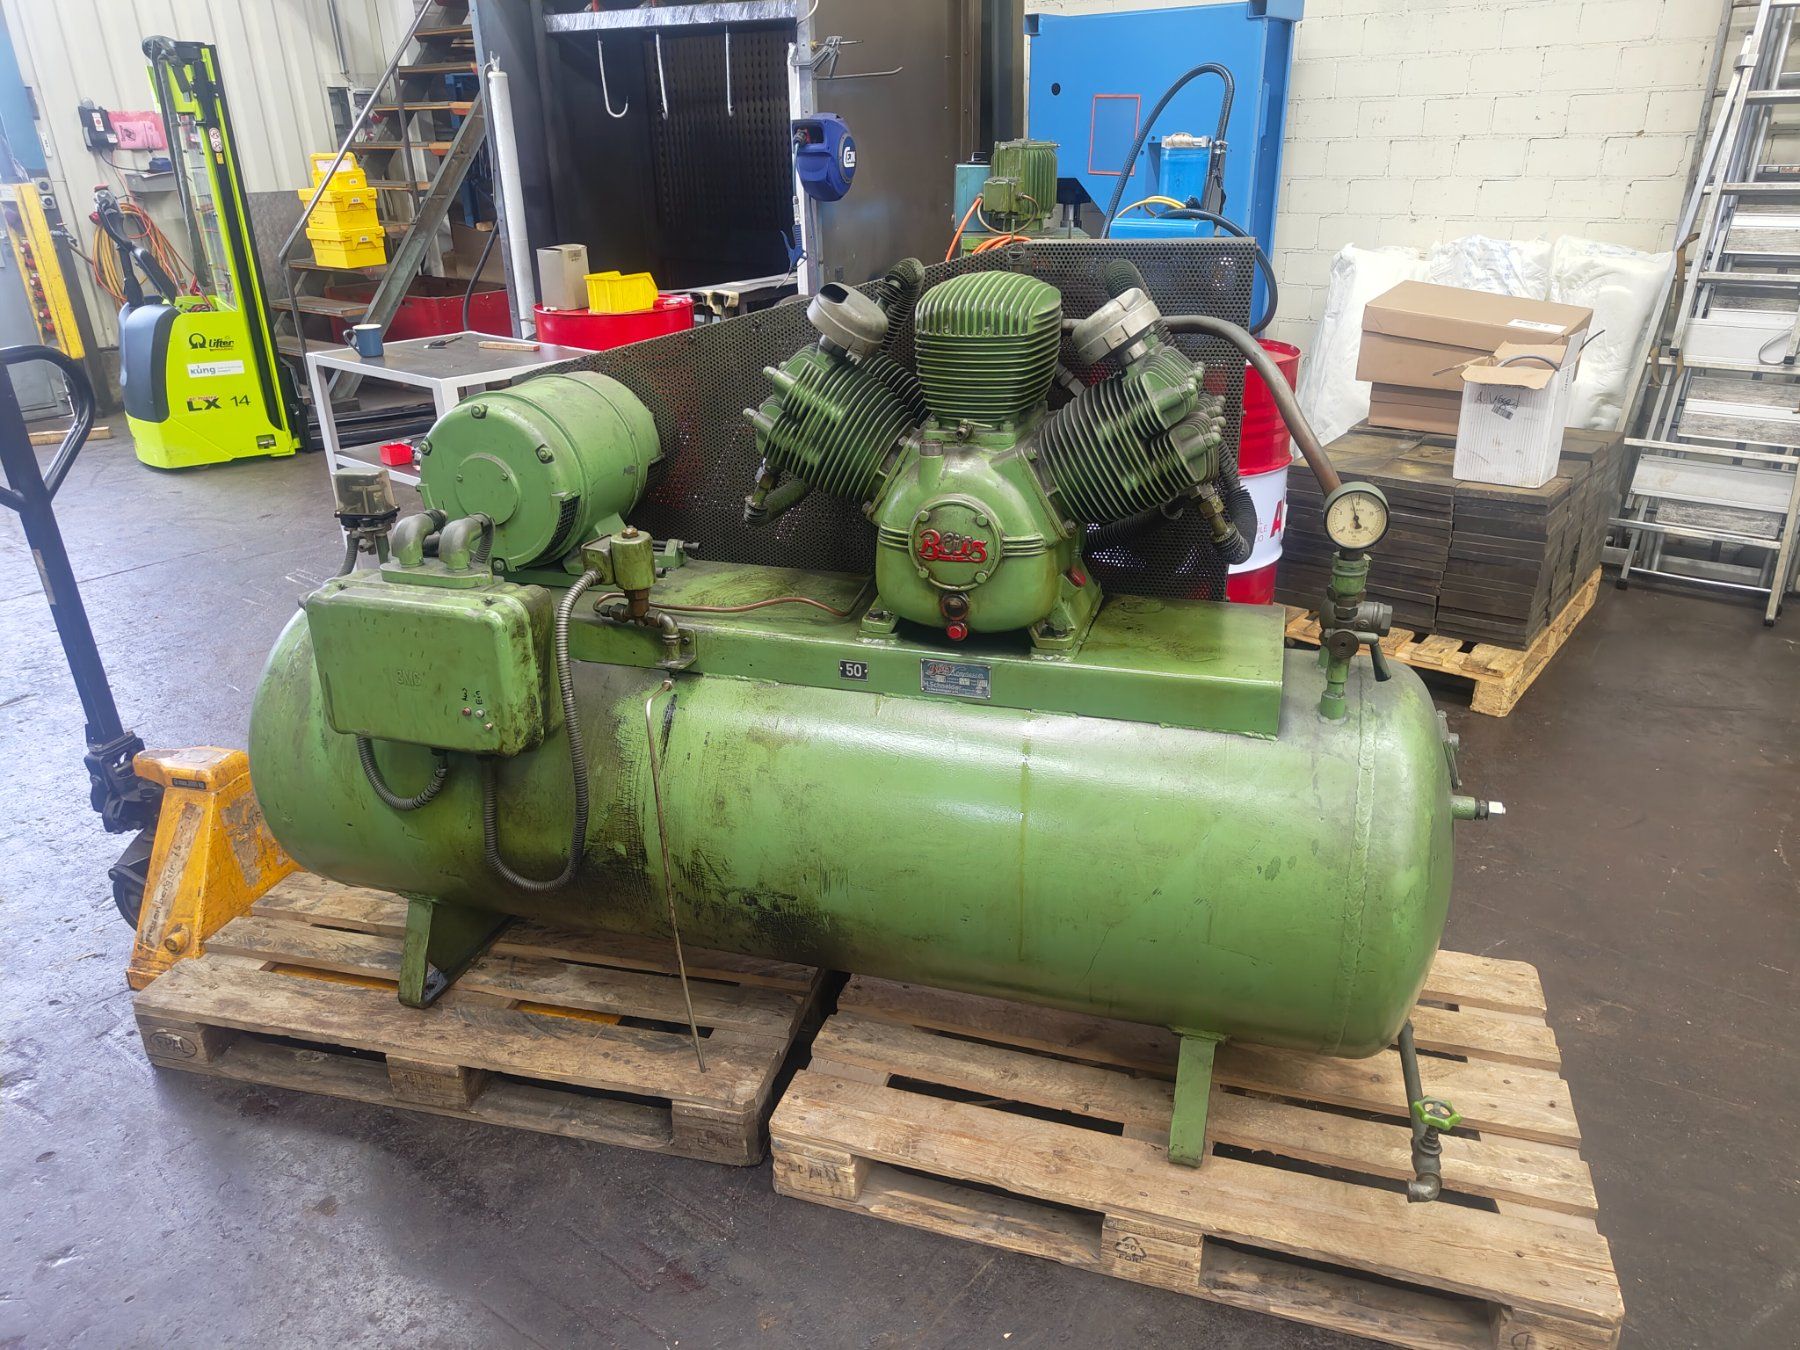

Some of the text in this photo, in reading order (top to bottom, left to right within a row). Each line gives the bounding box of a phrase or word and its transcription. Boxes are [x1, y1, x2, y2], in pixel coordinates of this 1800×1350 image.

[209, 338, 234, 348] Lifter
[187, 398, 222, 411] LX
[230, 395, 251, 407] 14
[845, 664, 862, 677] 50
